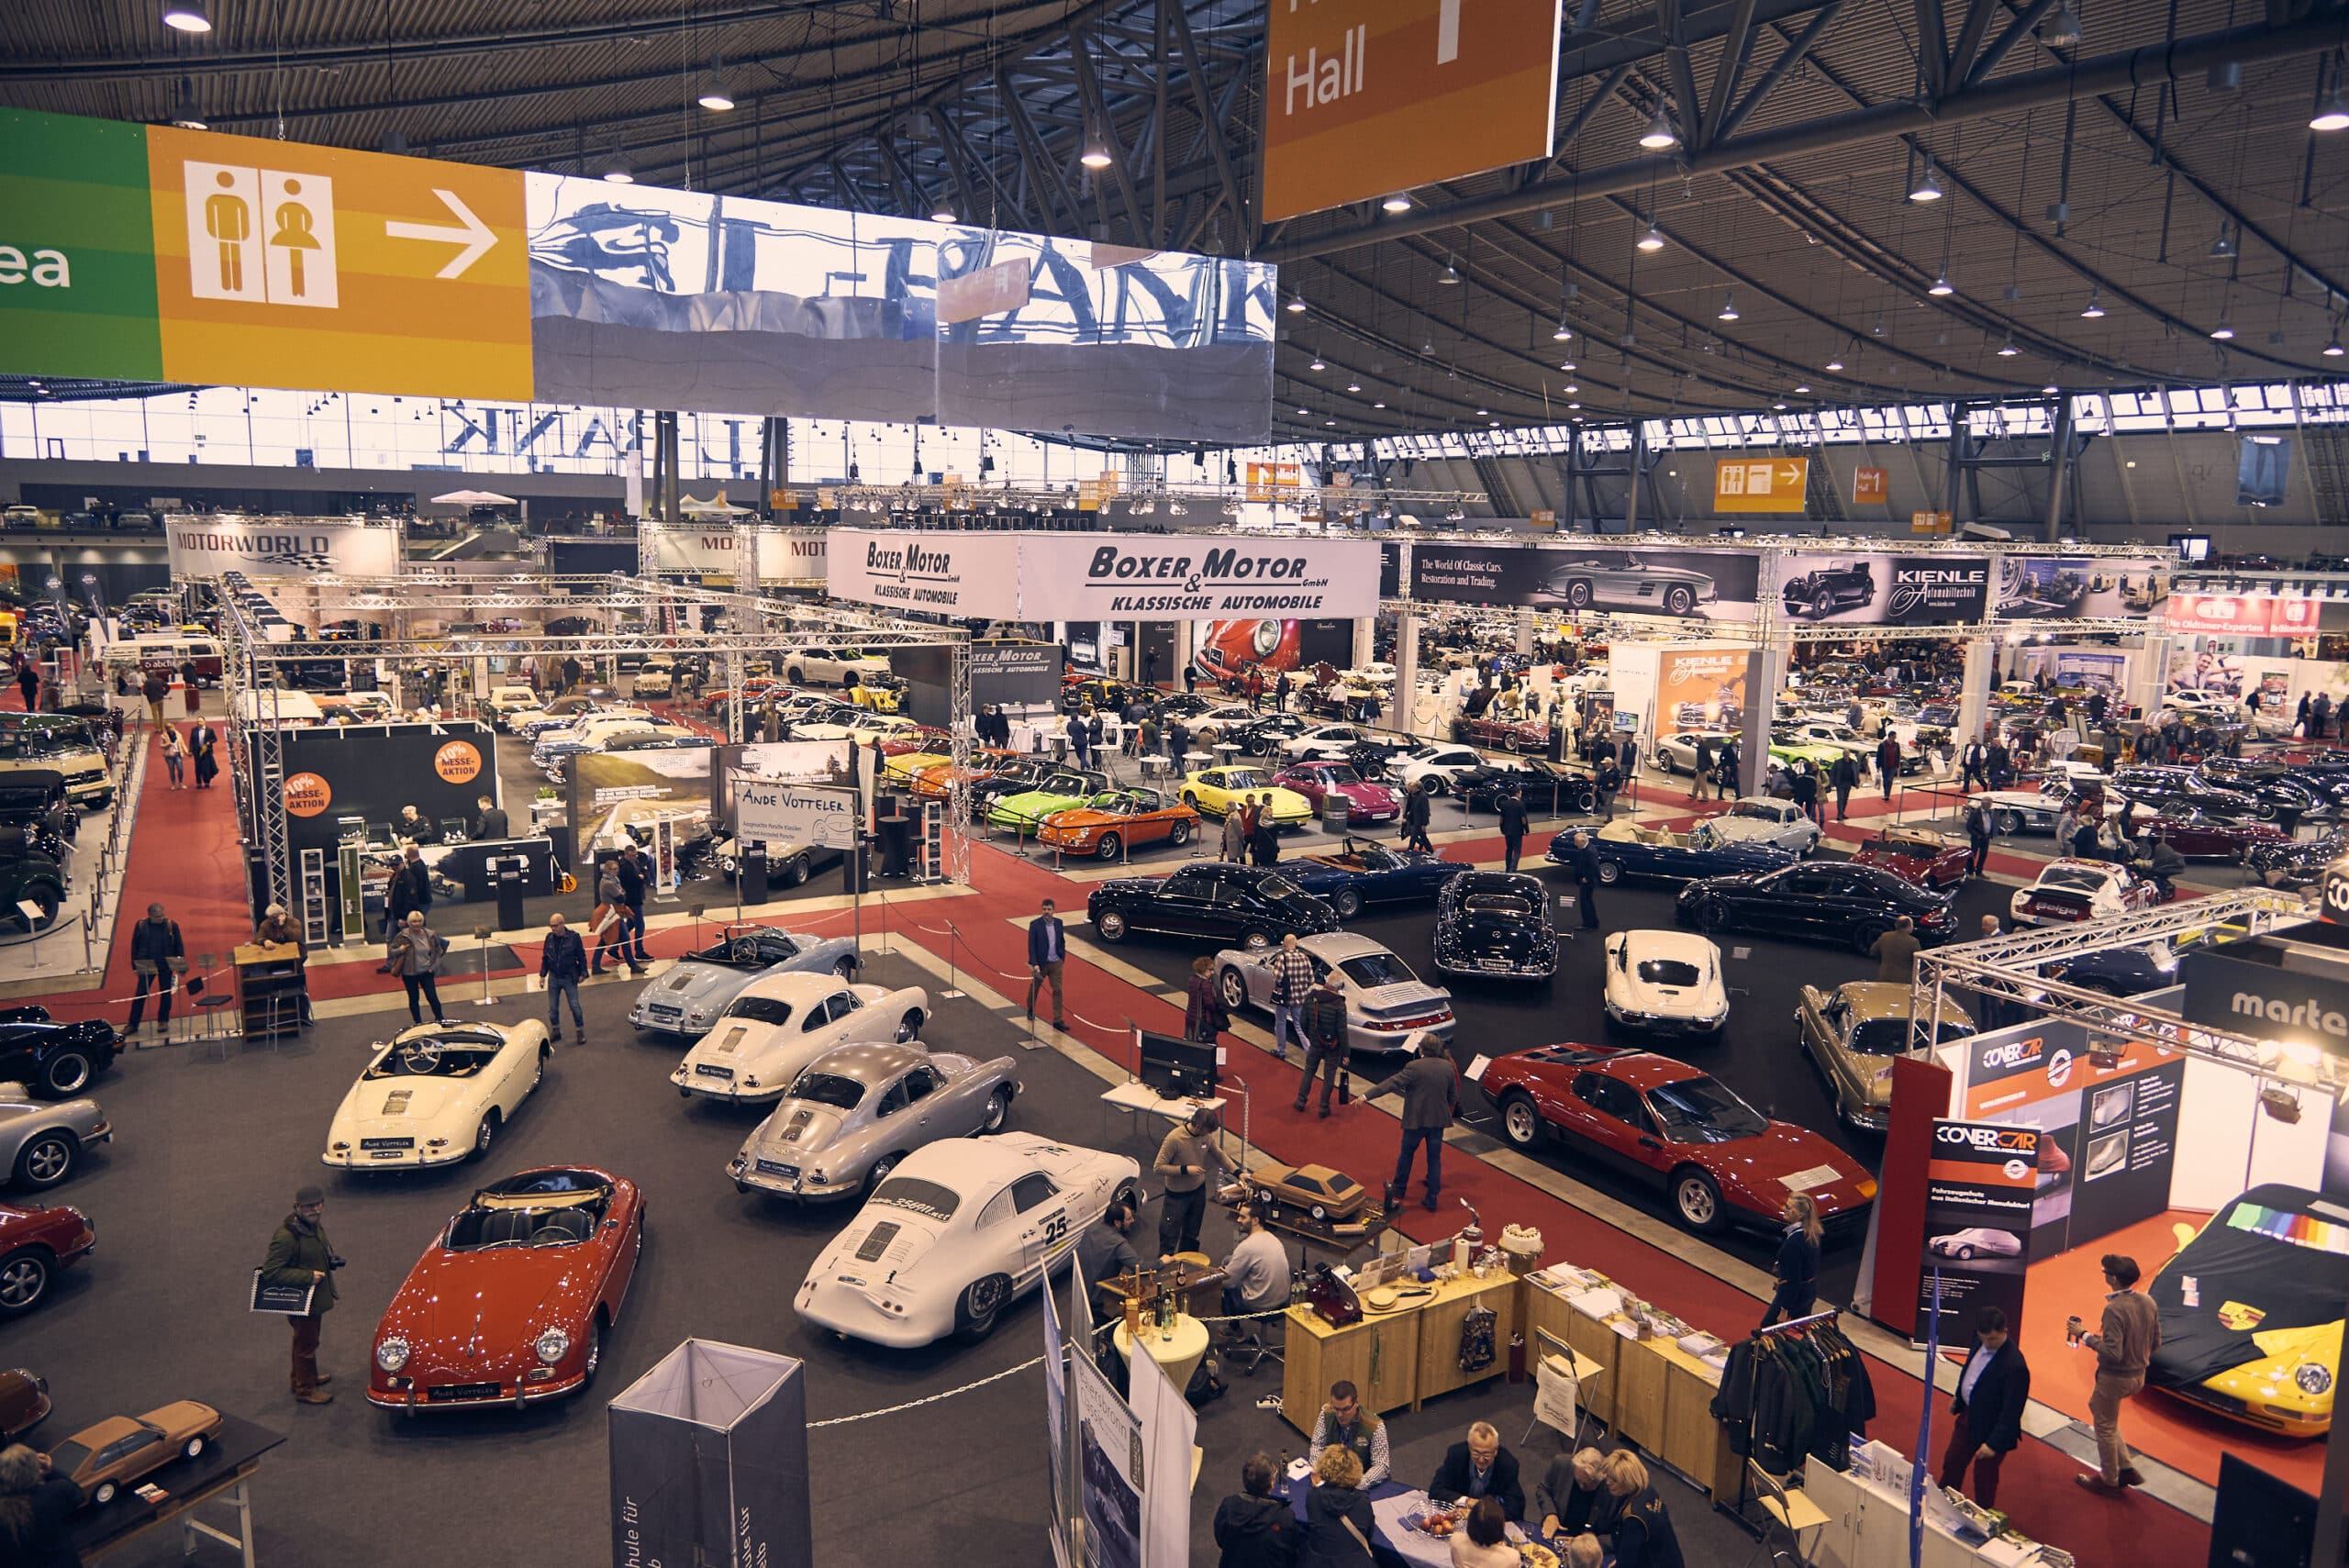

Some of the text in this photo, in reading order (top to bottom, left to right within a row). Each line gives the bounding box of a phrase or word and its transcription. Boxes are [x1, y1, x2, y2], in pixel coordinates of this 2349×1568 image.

[1286, 24, 1365, 116] Hall
[0, 246, 71, 287] ea
[177, 532, 329, 553] MOTORWORLD
[867, 541, 902, 570] BOXER
[906, 543, 951, 573] MOTOR
[1421, 559, 1503, 573] The World Of Classic Cars.
[1088, 546, 1329, 593] BOXER & MOTOR GmbH
[1898, 570, 1985, 583] KIENLE
[1421, 573, 1497, 589] Restoration and Trading.
[874, 584, 958, 605] KLASSISCHE AUTOMOBILE
[1110, 595, 1323, 610] KLASSISCHE AUTOMOBILE
[973, 652, 995, 662] XER
[998, 650, 1042, 662] MOTOR
[1675, 656, 1732, 666] KIENLE
[442, 767, 475, 775] AKTION
[289, 799, 325, 808] AKTION
[742, 788, 845, 812] ANDE VOTTELER
[2232, 992, 2348, 1037] marta
[1983, 1037, 2043, 1068] COVERCAR
[1936, 1126, 2037, 1150] COVERCAR
[1045, 1216, 1067, 1246] 25
[623, 1496, 639, 1524] für
